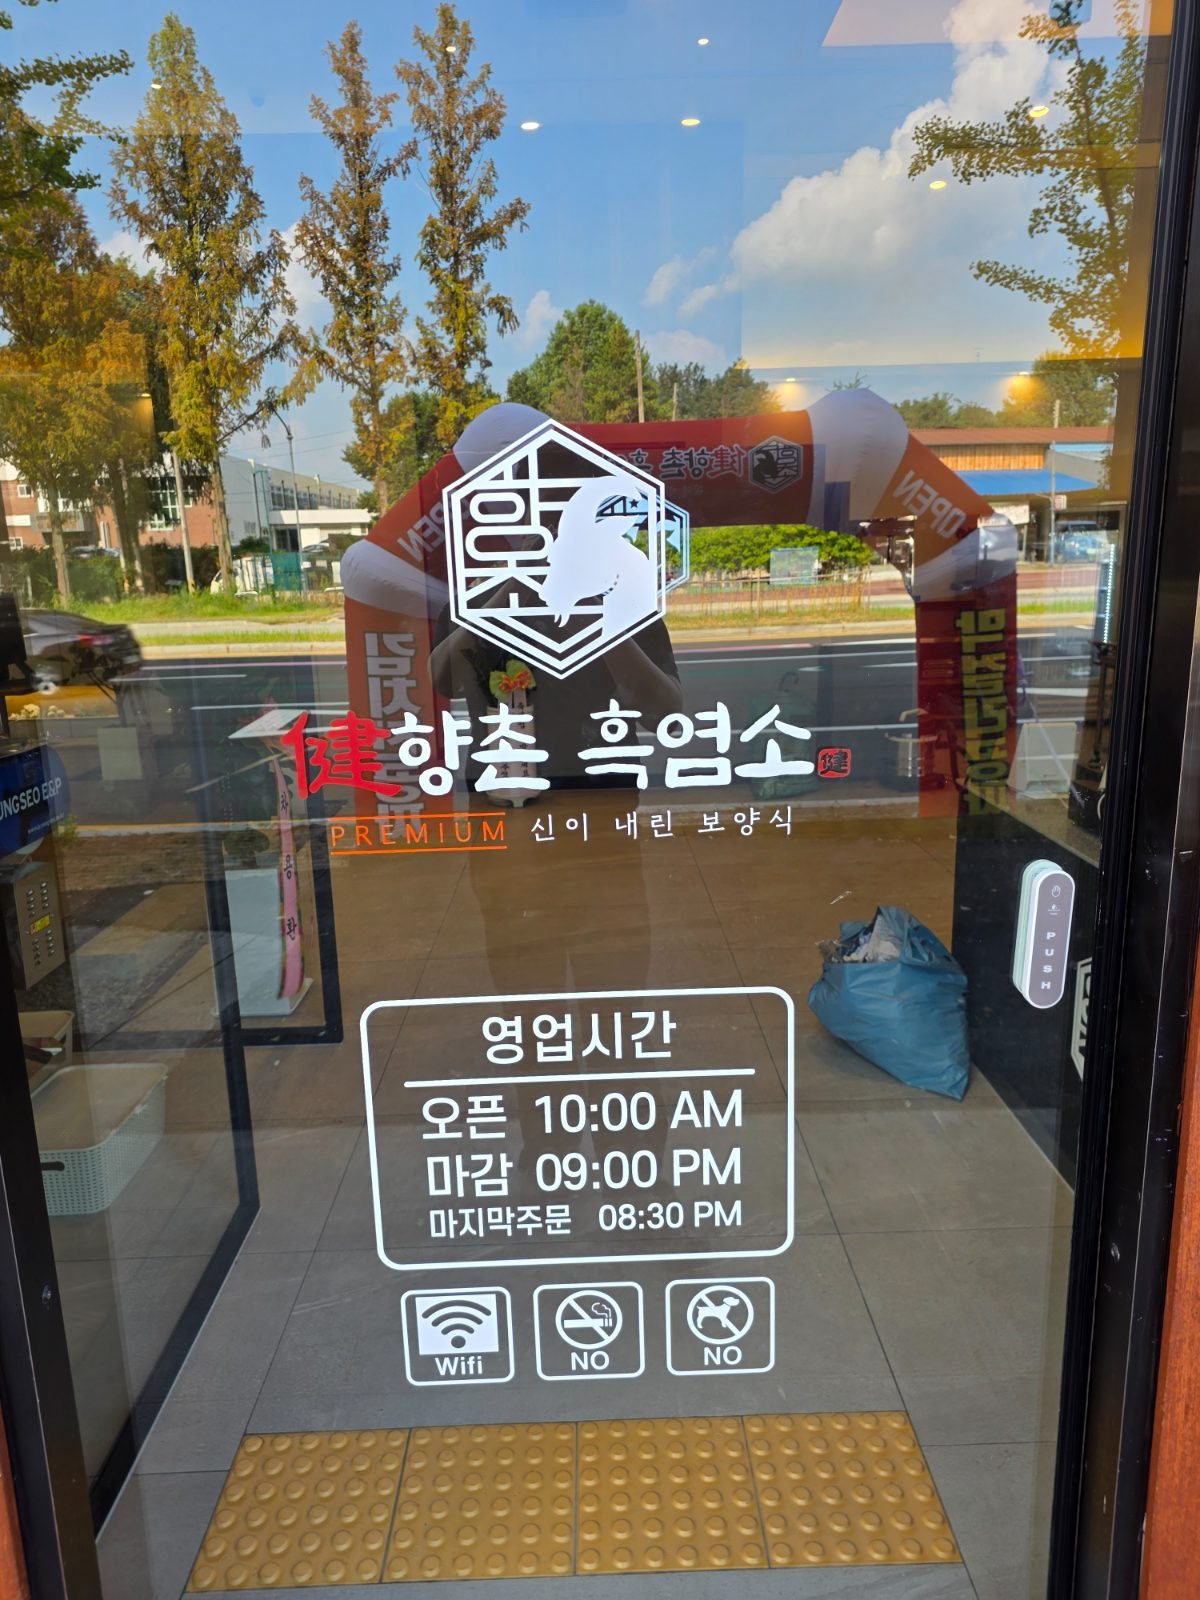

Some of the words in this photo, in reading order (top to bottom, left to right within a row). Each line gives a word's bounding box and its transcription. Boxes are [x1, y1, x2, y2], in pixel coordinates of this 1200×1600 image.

[577, 698, 815, 790] 흑염소
[41, 777, 62, 800] E&P
[331, 820, 505, 847] PREMIUM
[531, 813, 588, 842] 신이
[615, 810, 673, 840] 내린
[697, 805, 792, 836] 보양식
[1040, 931, 1056, 990] PUSH
[482, 1010, 677, 1065] 영업시간
[421, 1094, 508, 1140] 오픈
[535, 1091, 656, 1134] 10:00
[670, 1089, 742, 1129] AM
[427, 1152, 513, 1198] 마감
[535, 1149, 657, 1192] 09:00
[673, 1147, 741, 1187] PM
[429, 1204, 572, 1239] 마지막주문
[598, 1202, 684, 1232] 08:30
[694, 1200, 742, 1227] PM
[434, 1355, 483, 1376] Wifi
[570, 1350, 610, 1371] NO
[703, 1345, 742, 1366] NO
